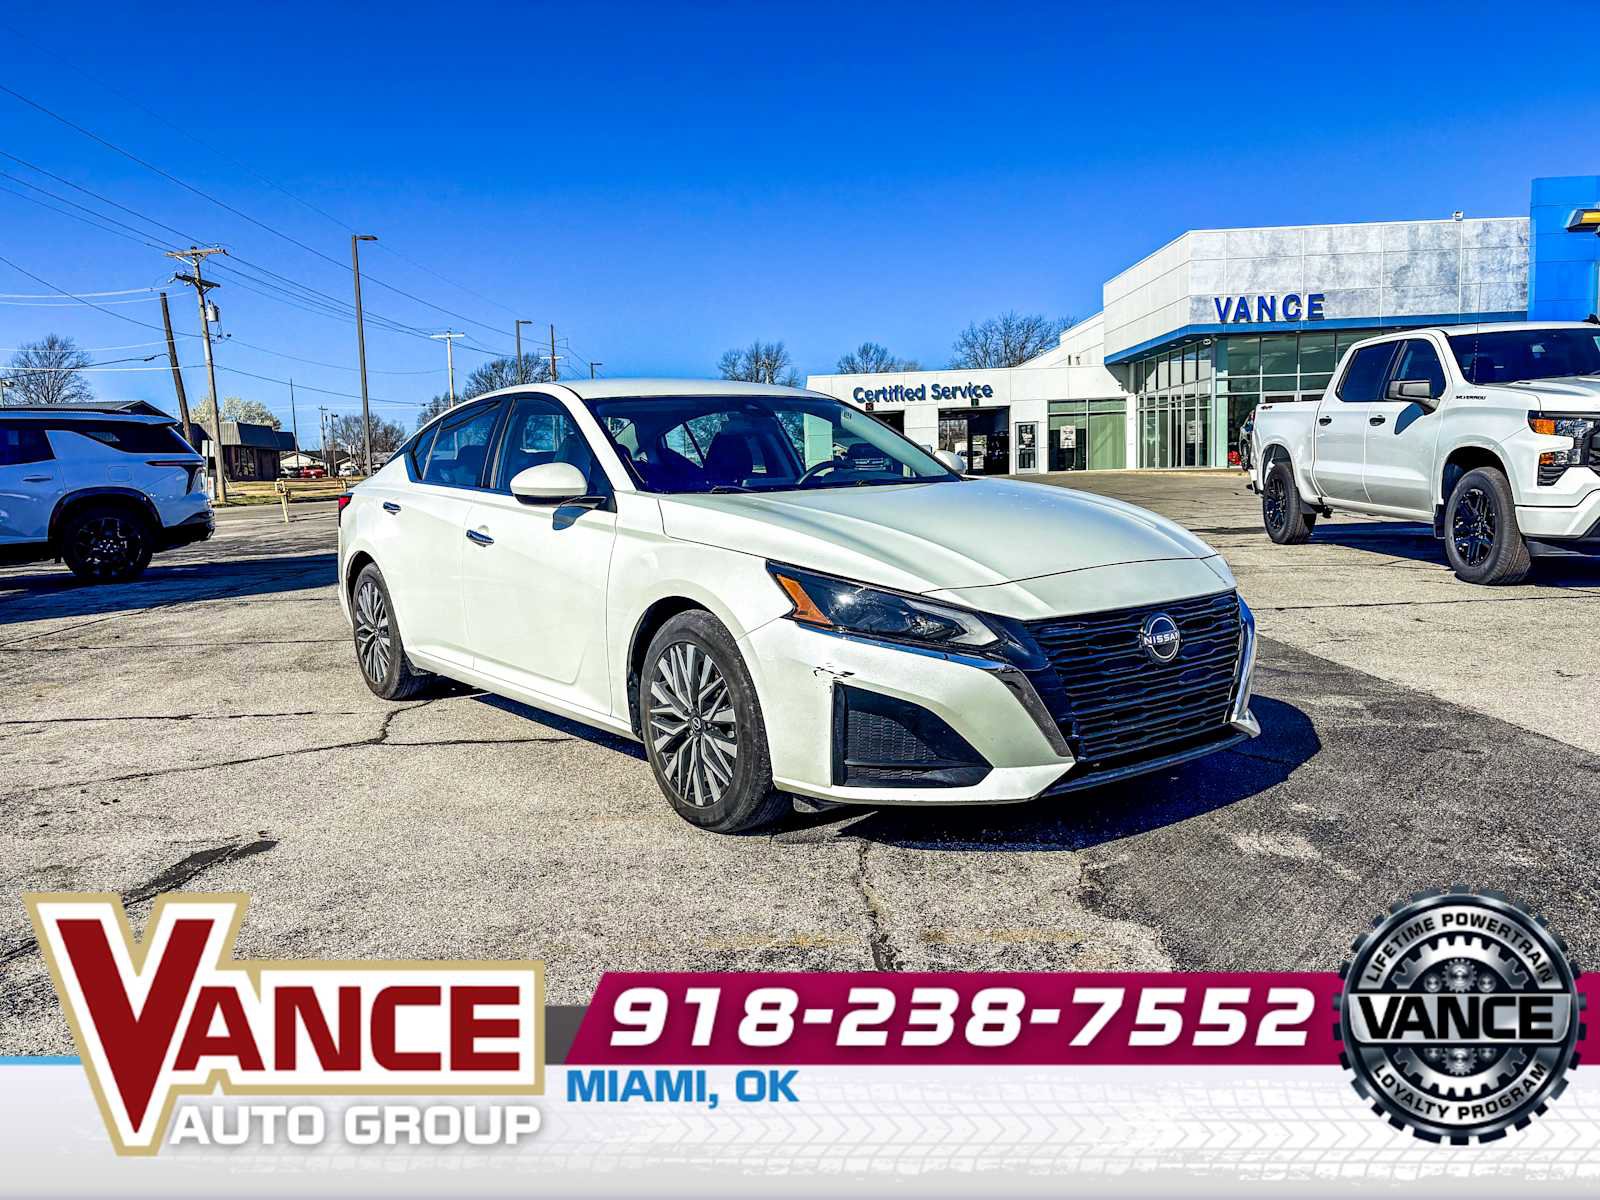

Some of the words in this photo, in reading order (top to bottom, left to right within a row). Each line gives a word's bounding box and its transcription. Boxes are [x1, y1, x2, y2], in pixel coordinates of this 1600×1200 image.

[1214, 293, 1325, 324] VANCE
[853, 384, 926, 403] Certified
[931, 382, 993, 400] Service
